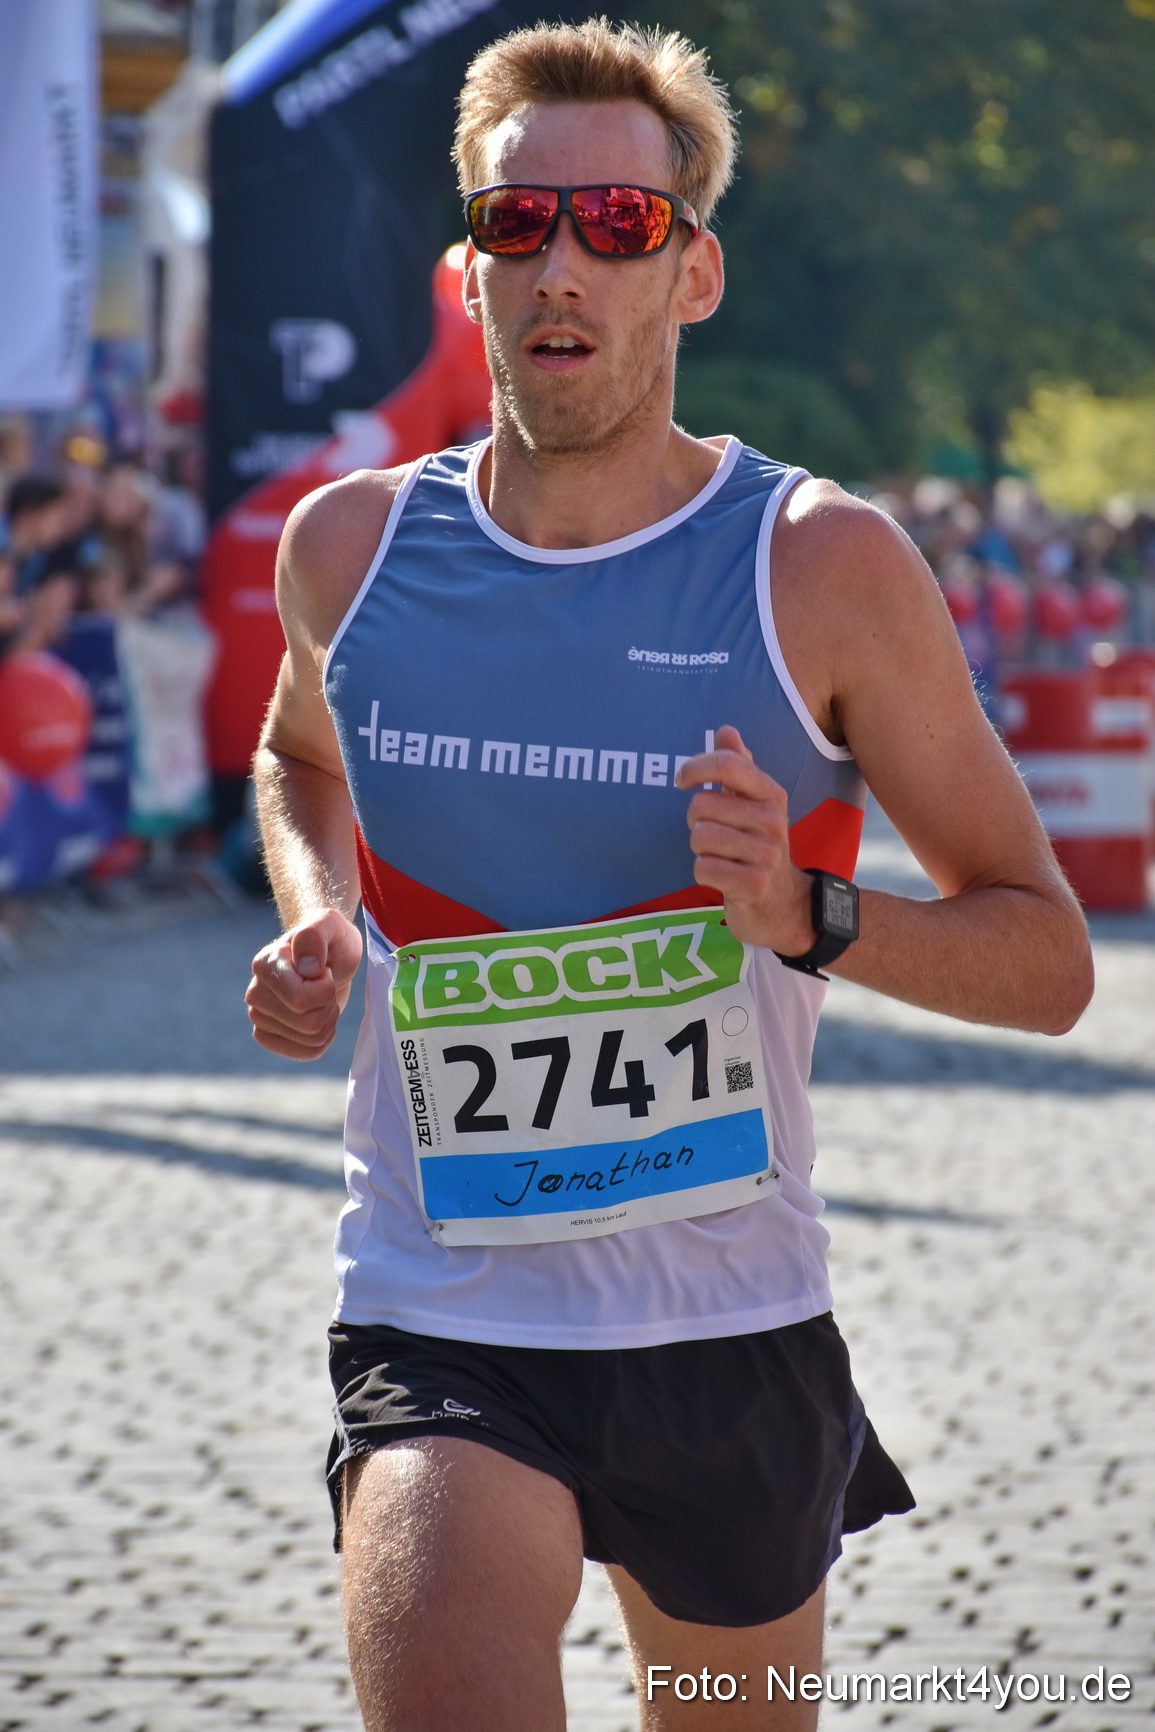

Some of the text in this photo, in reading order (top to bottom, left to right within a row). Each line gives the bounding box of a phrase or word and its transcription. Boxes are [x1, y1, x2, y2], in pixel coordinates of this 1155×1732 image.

[358, 700, 471, 770] team
[417, 924, 717, 1018] BOCK
[419, 1037, 442, 1146] TRANSPONDER ZEITMESSUNG
[442, 1018, 710, 1134] 2741
[494, 1145, 695, 1207] Jonathan
[615, 1211, 627, 1219] Lauf
